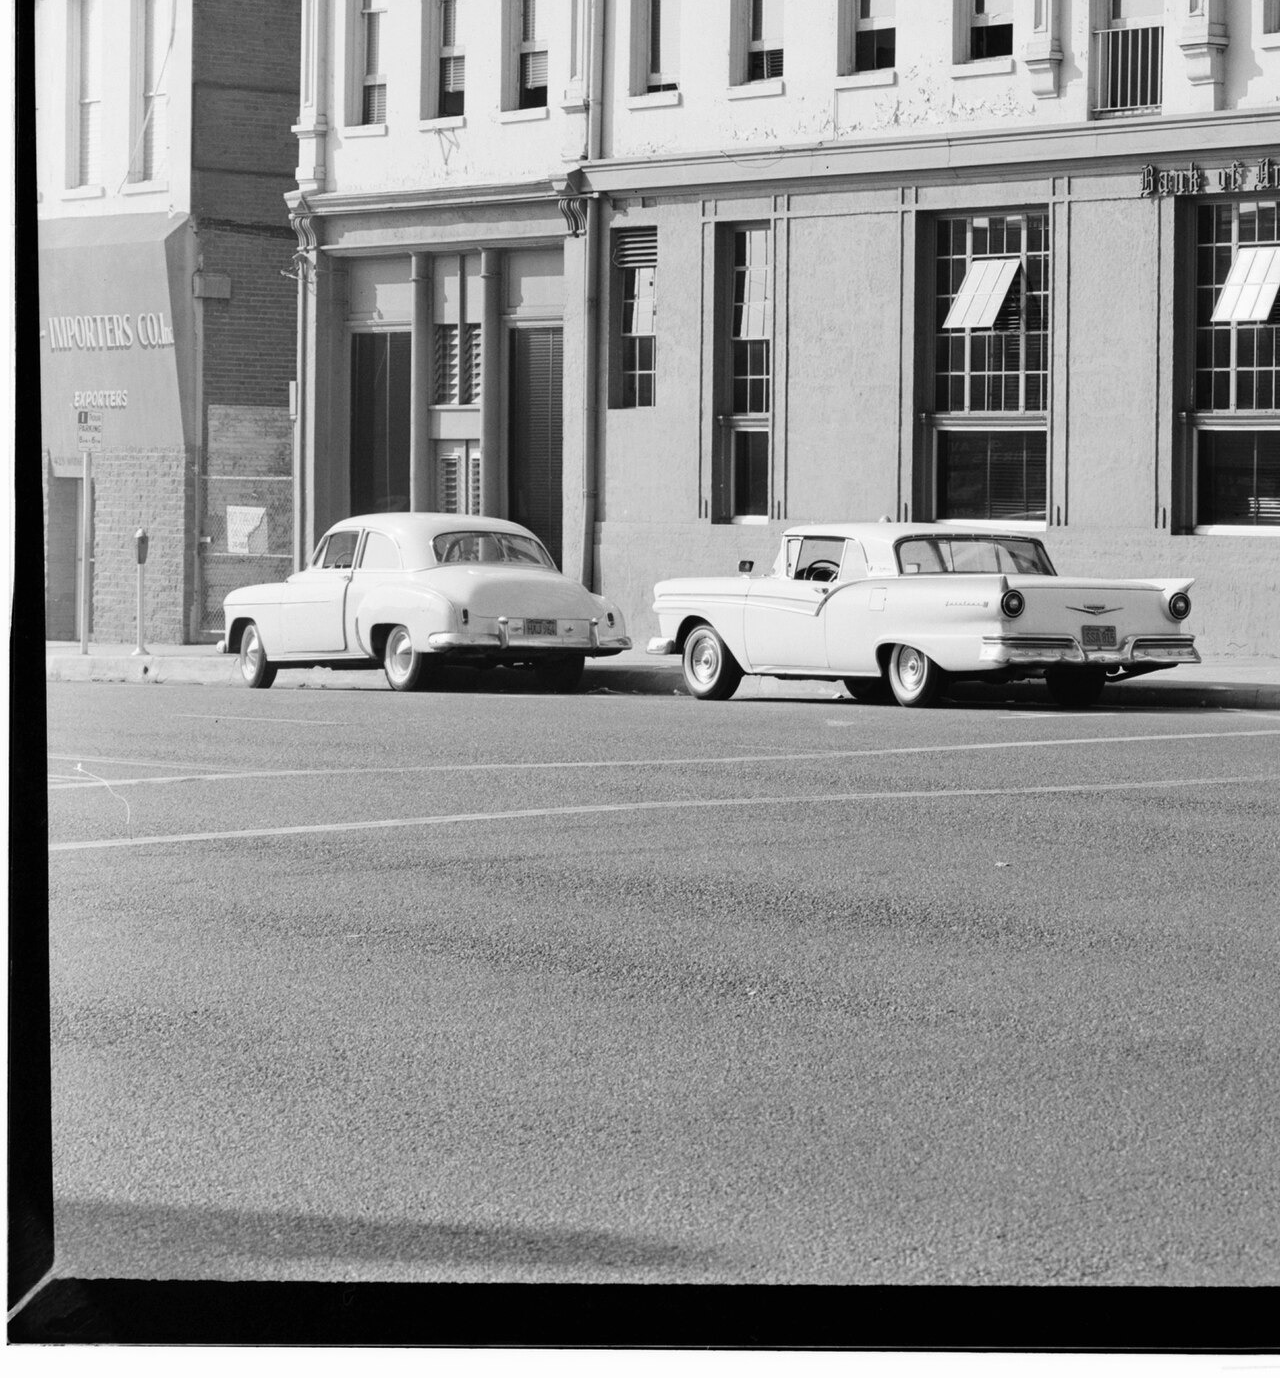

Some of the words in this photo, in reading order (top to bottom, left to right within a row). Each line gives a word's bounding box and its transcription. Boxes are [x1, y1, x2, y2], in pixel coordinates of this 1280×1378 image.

[1140, 162, 1201, 198] Bank
[1219, 160, 1244, 191] of
[48, 314, 133, 349] IMPORTERS
[73, 389, 129, 407] EXPORTERS
